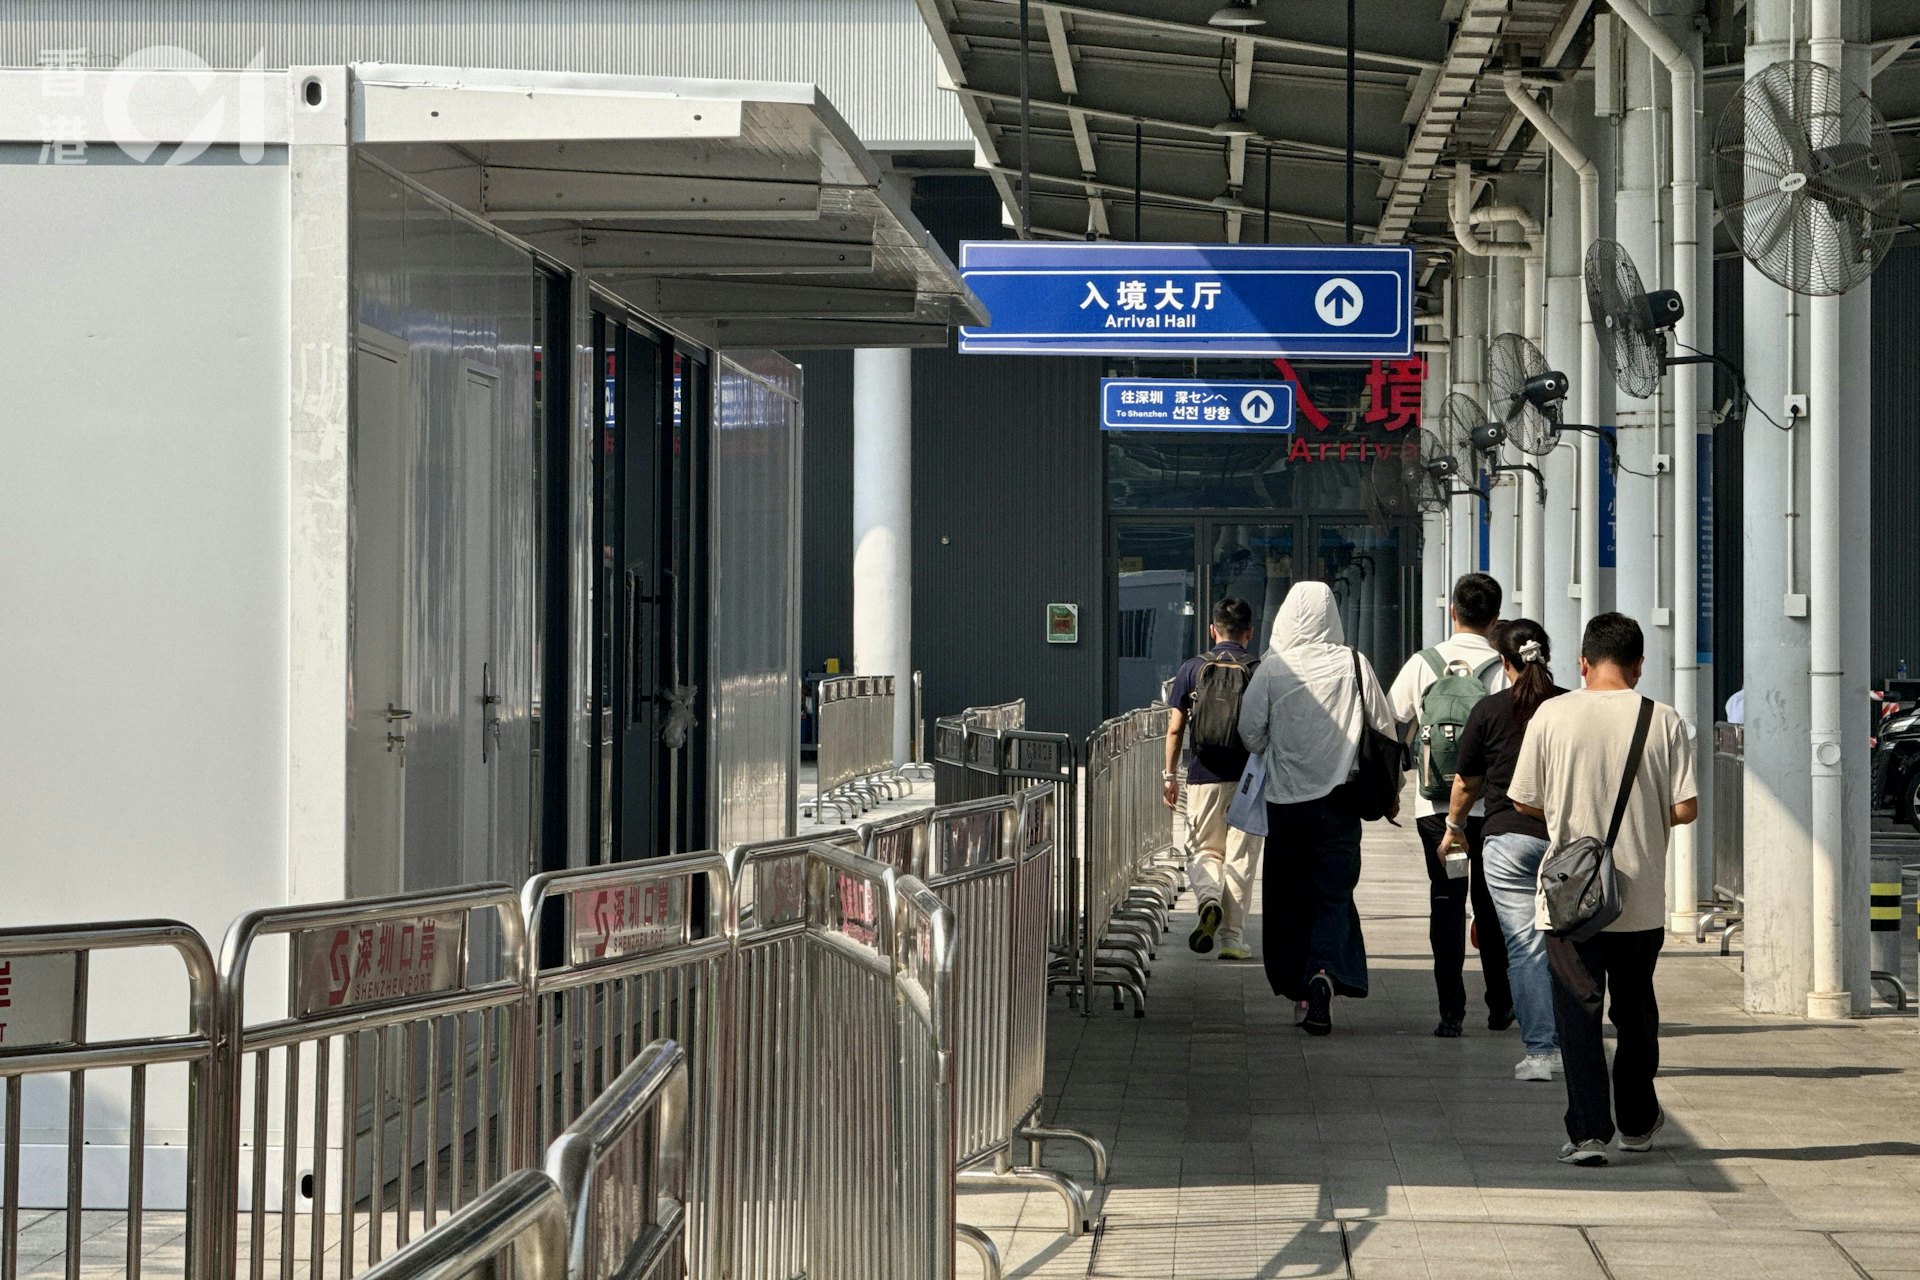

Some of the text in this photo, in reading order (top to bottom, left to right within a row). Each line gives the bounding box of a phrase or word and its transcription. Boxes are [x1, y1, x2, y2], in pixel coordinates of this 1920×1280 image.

[1079, 280, 1222, 310] 入境大厅
[1105, 314, 1196, 328] Arrival Hall
[1120, 390, 1163, 405] 往深圳
[1175, 391, 1228, 405] 深センへ
[1116, 410, 1168, 418] To Shenzhen
[1172, 406, 1231, 420] 선전 방향
[613, 880, 669, 933] 深圳口岸
[355, 919, 436, 979] 深圳口岸
[355, 972, 432, 1001] SHENZHEN PORT
